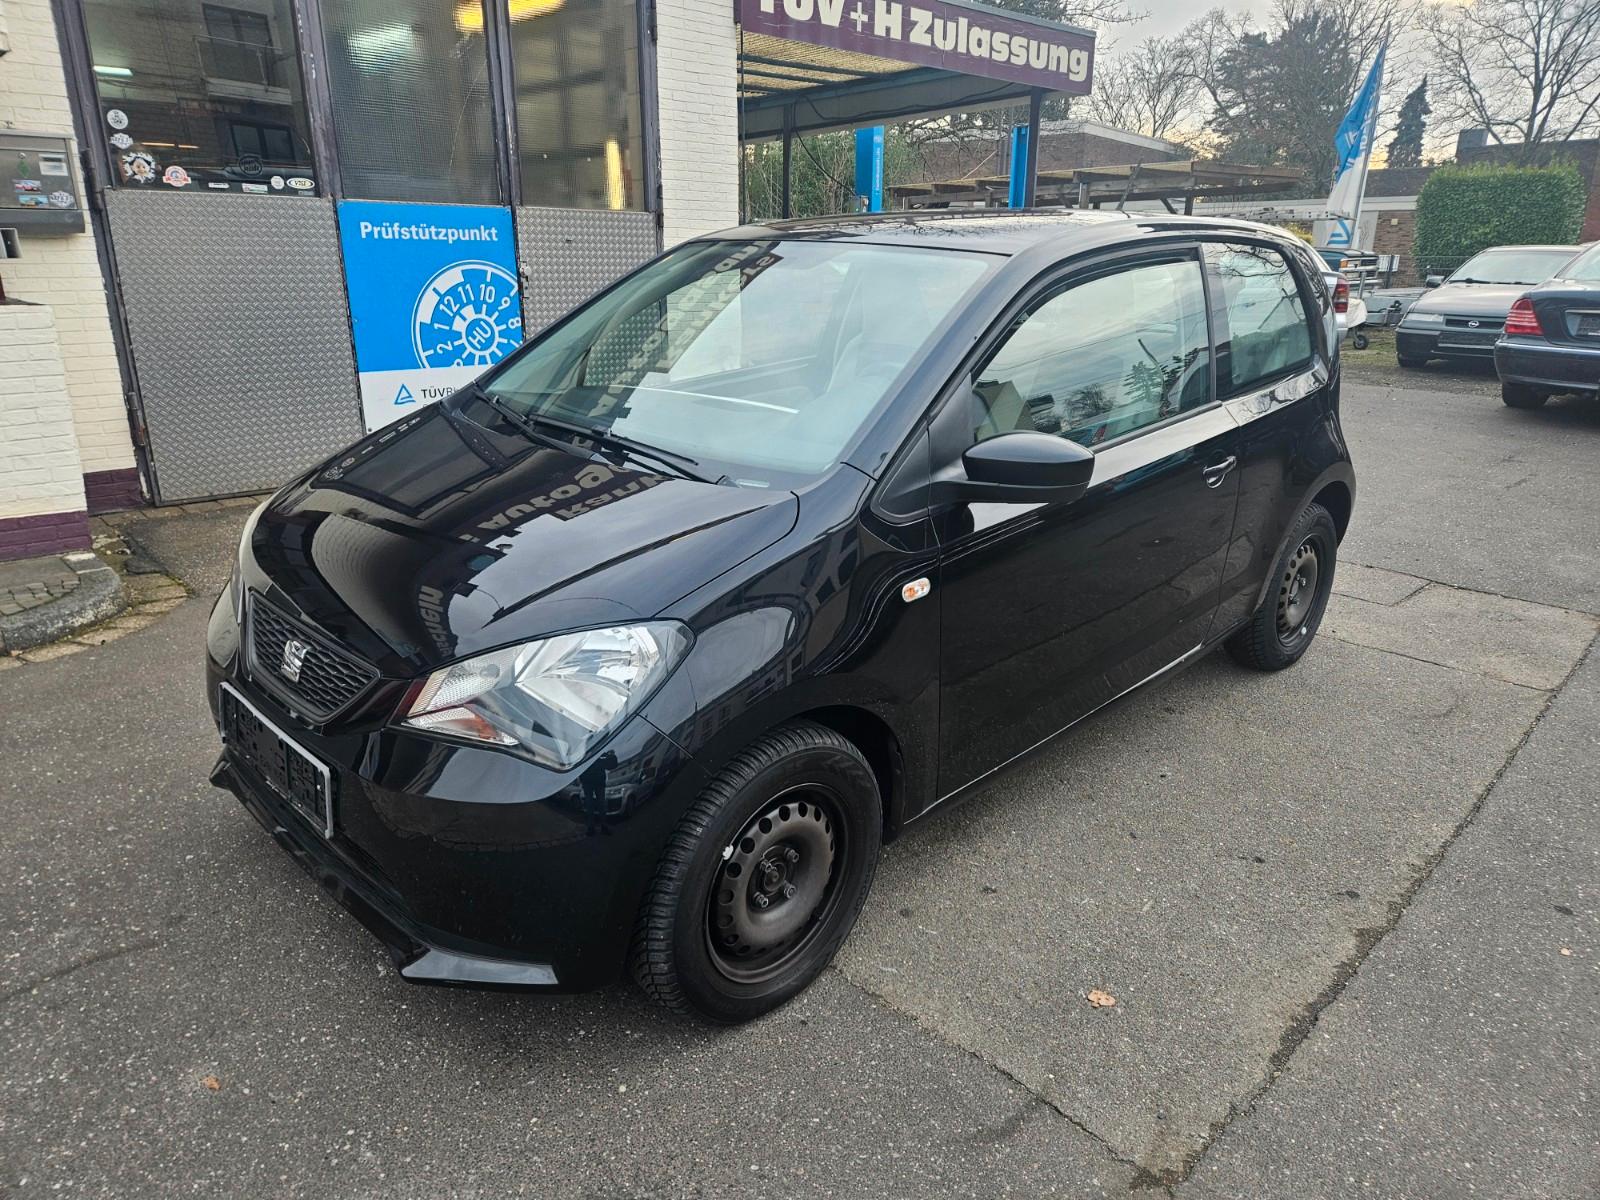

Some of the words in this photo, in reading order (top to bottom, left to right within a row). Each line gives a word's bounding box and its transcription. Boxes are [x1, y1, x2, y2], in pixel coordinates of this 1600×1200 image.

[910, 7, 1089, 82] Zulassung
[360, 222, 498, 243] Prüfstützpunkt
[439, 296, 460, 317] 12
[458, 284, 475, 303] 11
[480, 284, 496, 303] 10
[498, 297, 511, 311] 9
[508, 317, 522, 329] 8
[434, 322, 450, 330] 1
[468, 321, 492, 349] HU
[437, 341, 453, 354] 2
[421, 386, 456, 399] TÜVR
